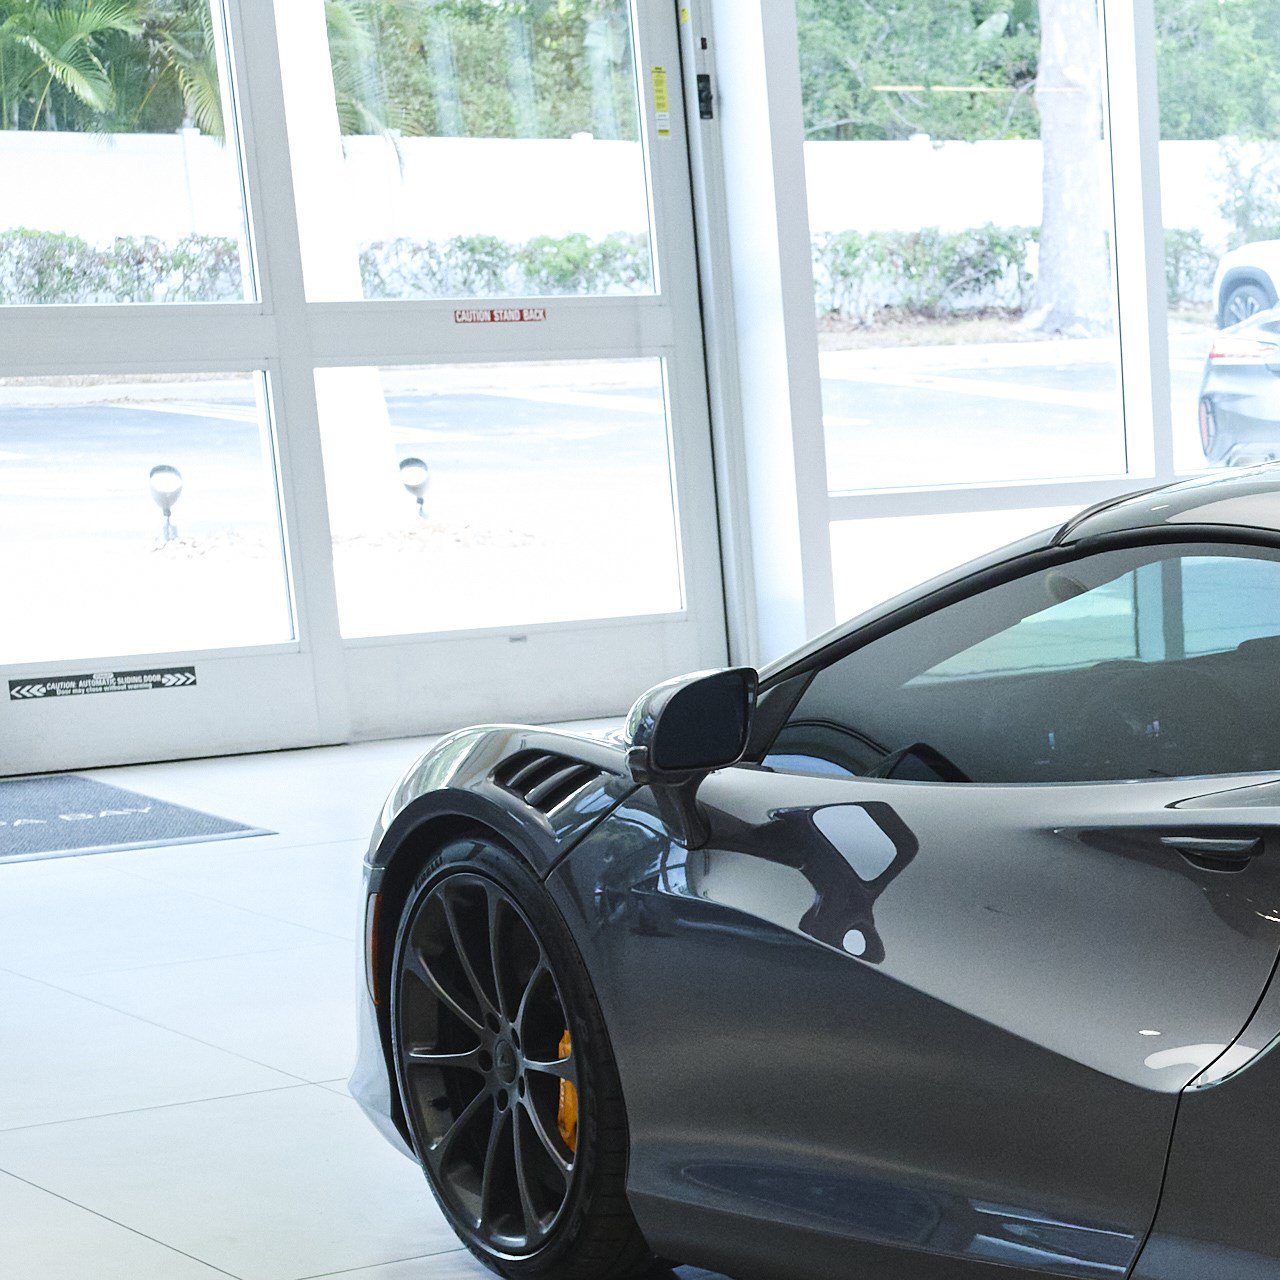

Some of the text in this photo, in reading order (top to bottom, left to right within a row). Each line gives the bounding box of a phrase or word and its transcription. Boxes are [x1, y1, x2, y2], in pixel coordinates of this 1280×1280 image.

[456, 309, 544, 322] CAUTION STAND BACK
[78, 677, 116, 688] AUTOMATIC
[117, 676, 142, 685] SLIDING
[143, 674, 161, 682] DOOR
[56, 688, 71, 696] Door
[59, 806, 152, 822] BAY
